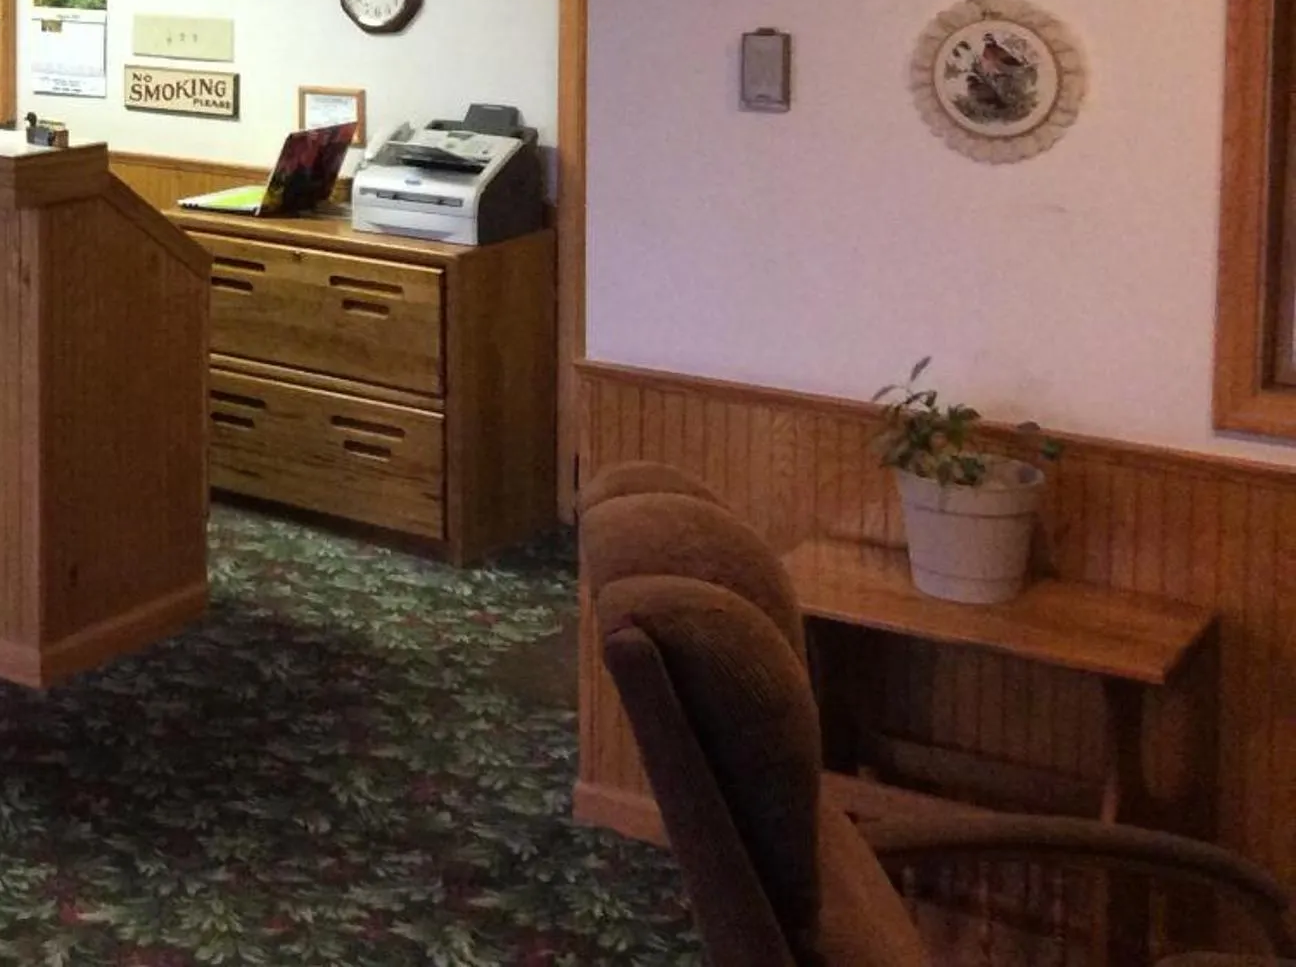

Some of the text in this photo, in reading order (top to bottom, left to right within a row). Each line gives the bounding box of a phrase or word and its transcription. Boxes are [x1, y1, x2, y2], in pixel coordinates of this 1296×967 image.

[132, 72, 153, 84] NO
[129, 78, 227, 102] SMOKING
[193, 98, 231, 110] PLEASE
